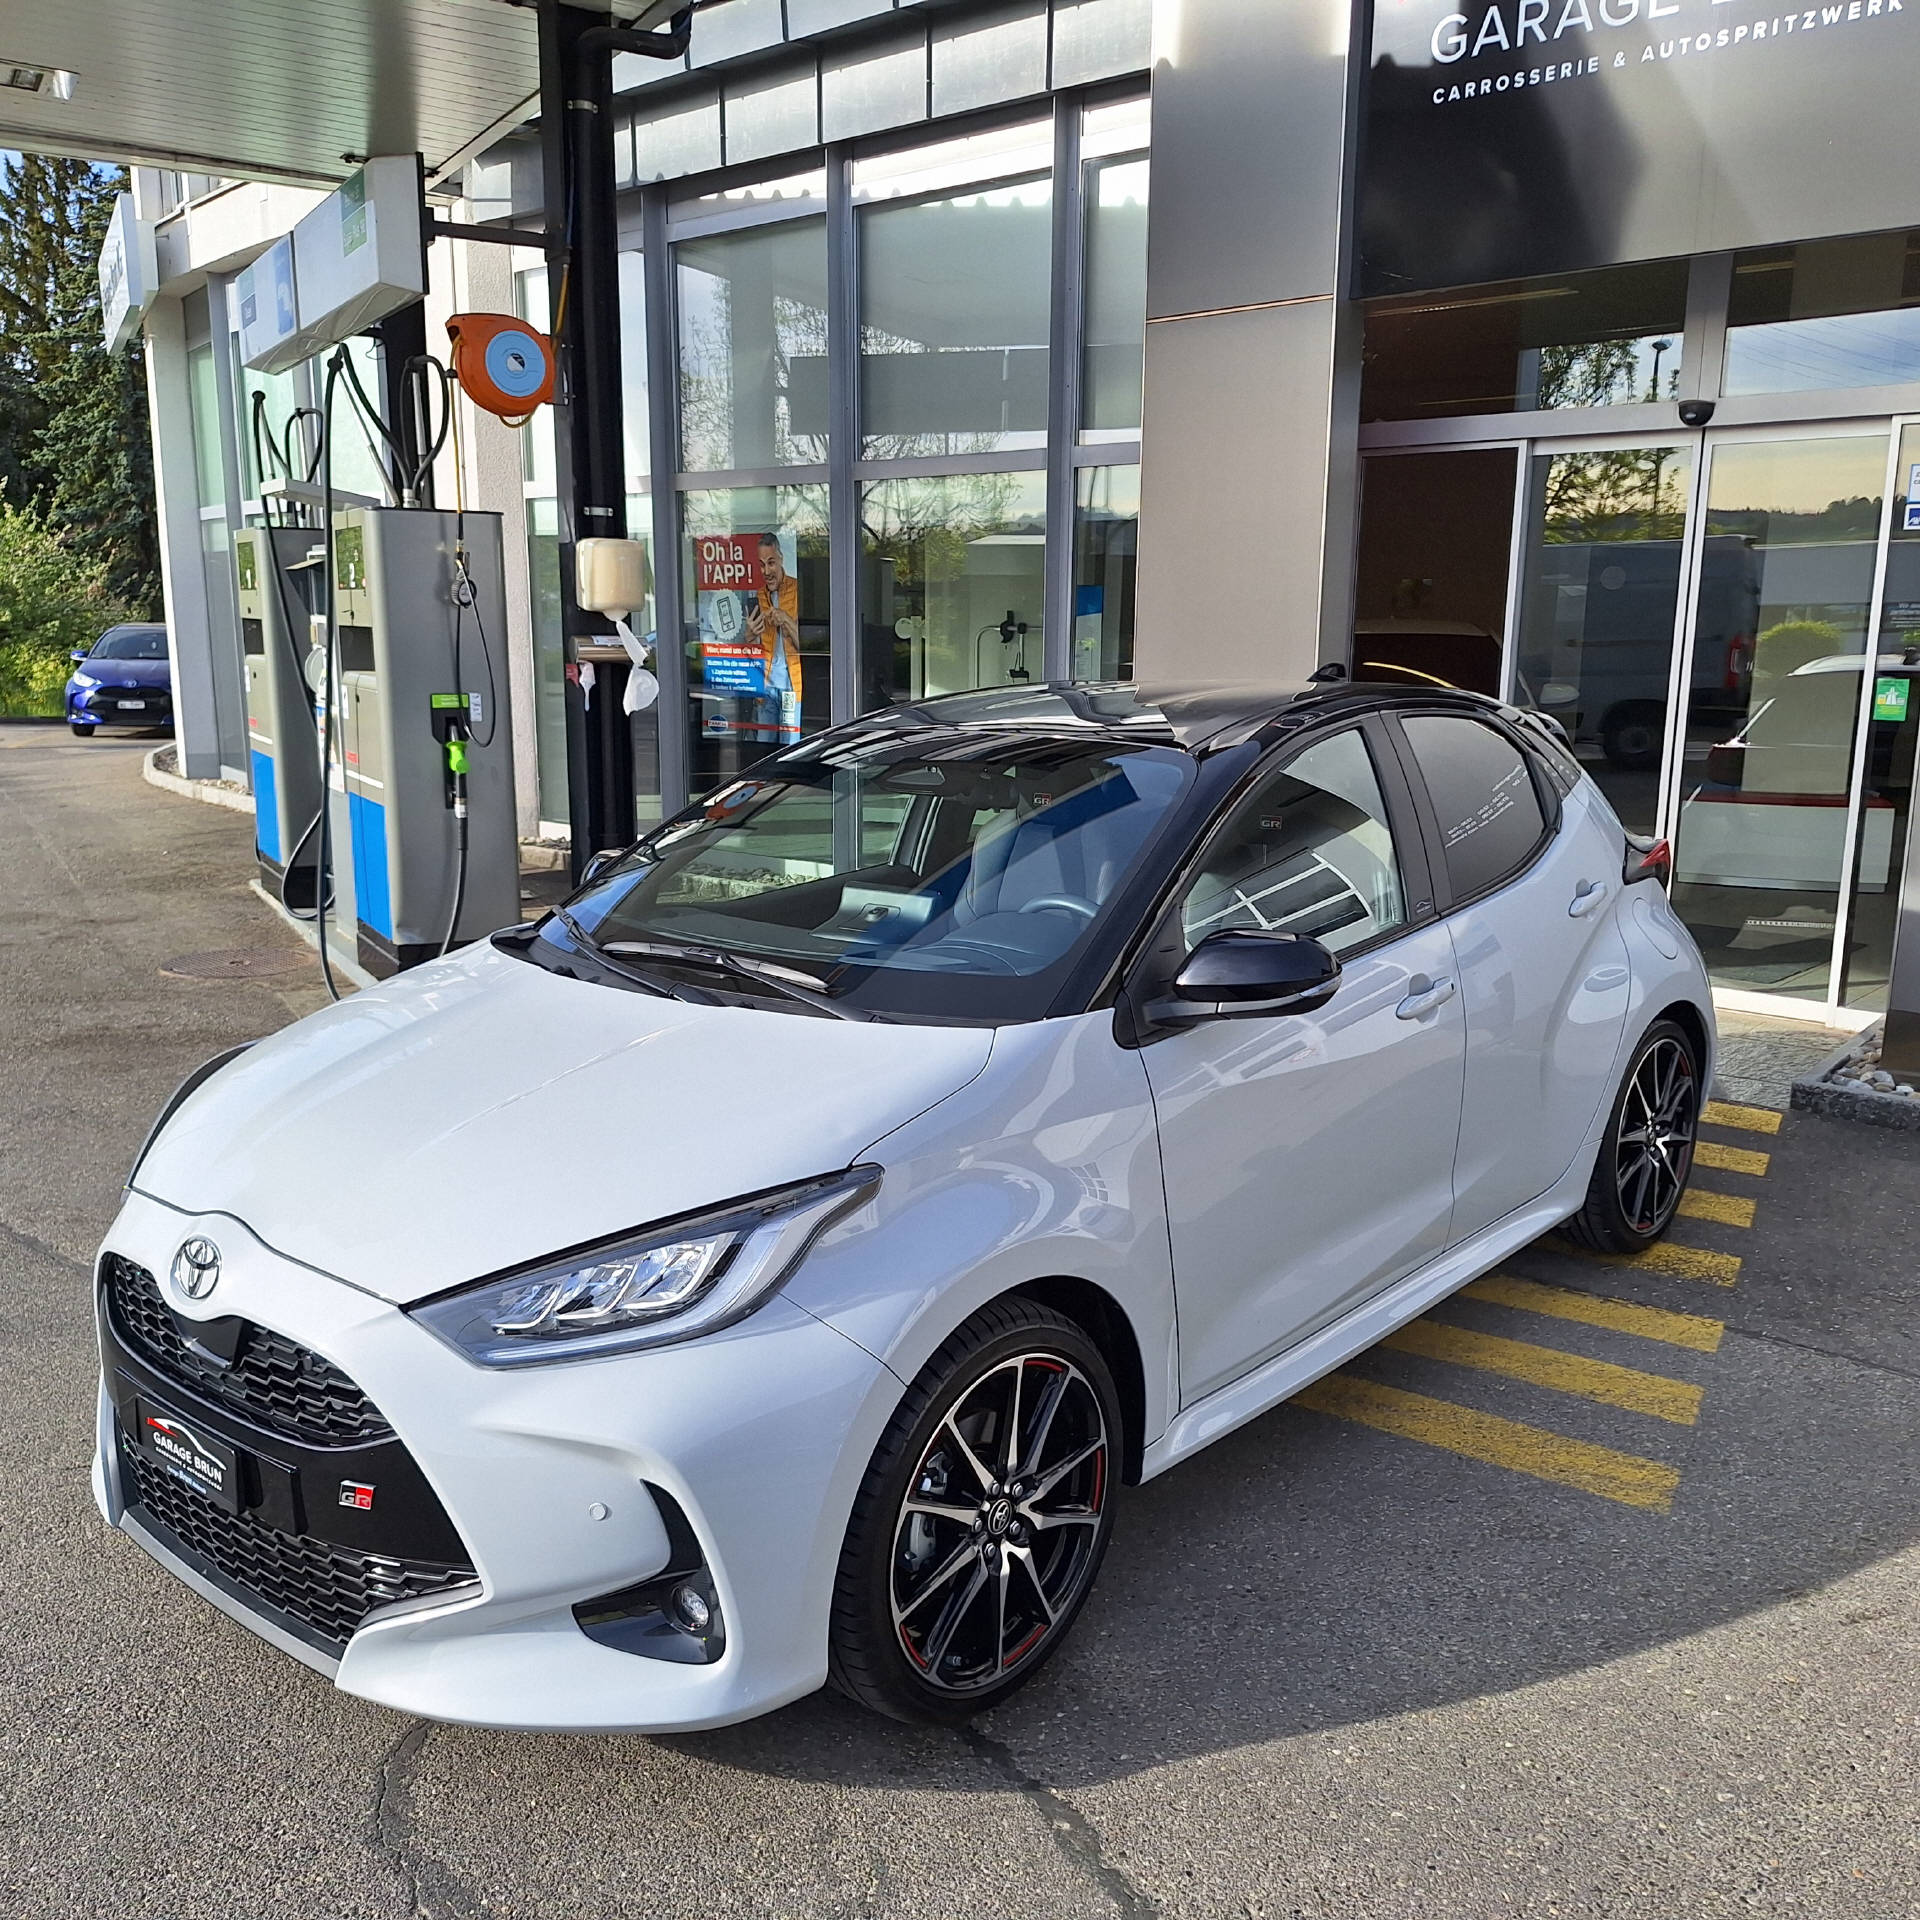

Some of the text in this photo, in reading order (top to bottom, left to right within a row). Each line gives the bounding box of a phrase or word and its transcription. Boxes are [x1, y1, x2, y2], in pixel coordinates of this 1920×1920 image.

[1432, 0, 1904, 104] CARROSSERIE & AUTOSPRITZWERK
[703, 541, 744, 562] Oh la
[703, 563, 753, 584] l'APP!
[153, 1431, 193, 1464] GARAGE
[193, 1455, 223, 1484] BRUN
[340, 1489, 372, 1509] GR
